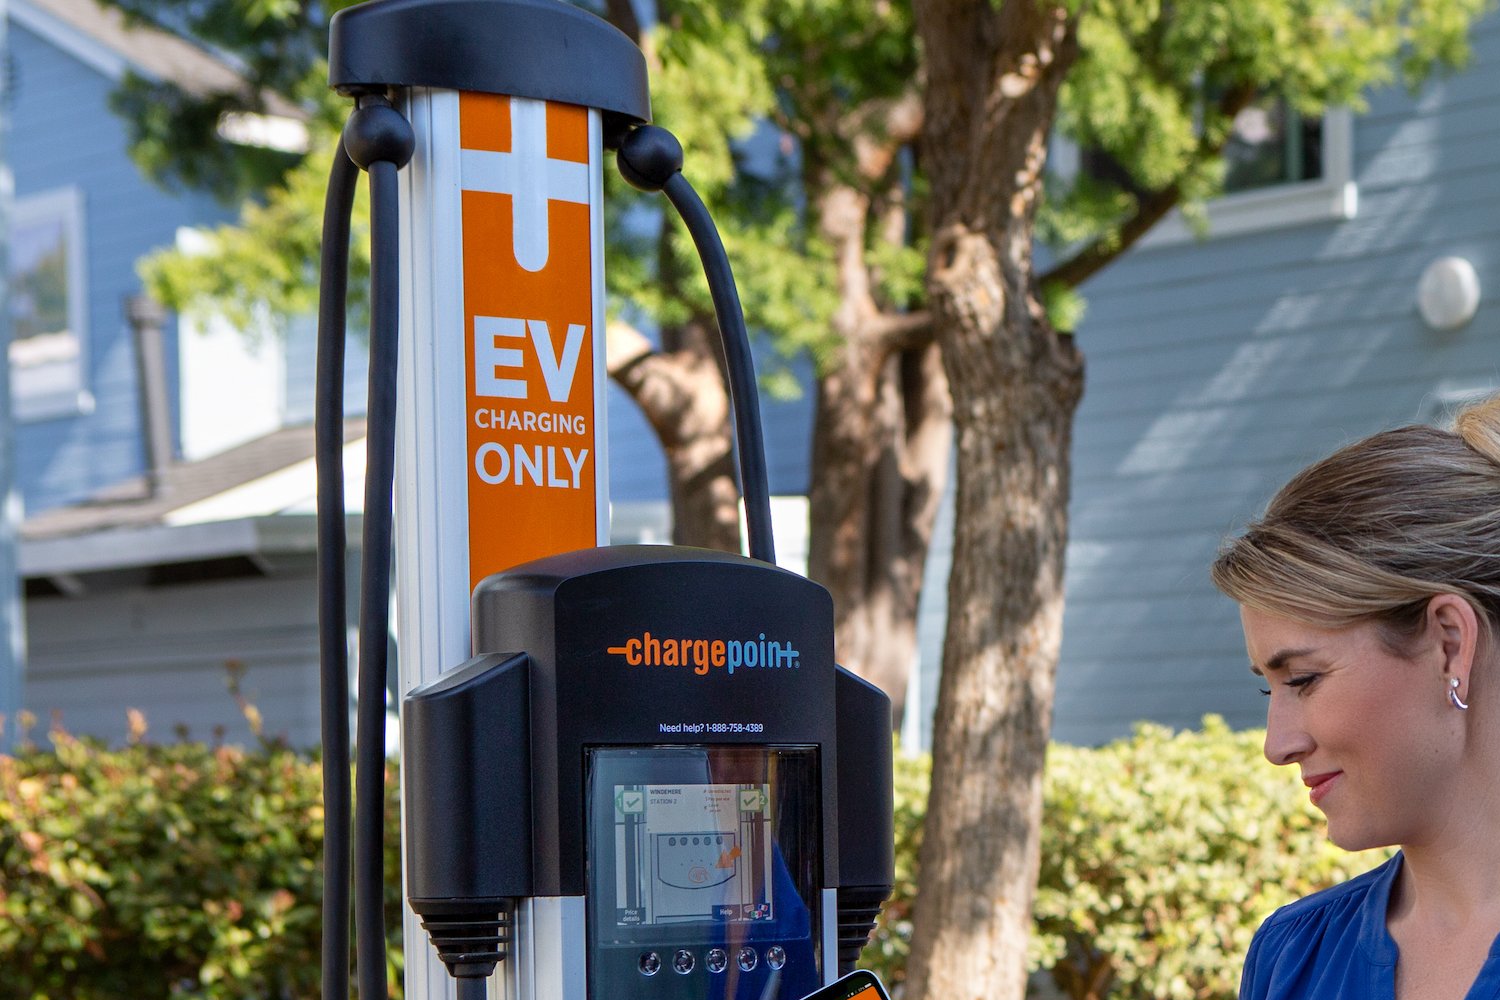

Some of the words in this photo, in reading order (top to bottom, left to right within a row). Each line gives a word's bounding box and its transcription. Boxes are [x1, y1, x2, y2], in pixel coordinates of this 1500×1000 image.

[474, 315, 586, 403] EV
[474, 407, 586, 435] CHARGING
[474, 441, 589, 490] ONLY
[607, 632, 799, 675] chargepoint
[659, 723, 681, 733] Need
[683, 723, 704, 733] help?
[705, 723, 764, 733] 1-888-758-4389
